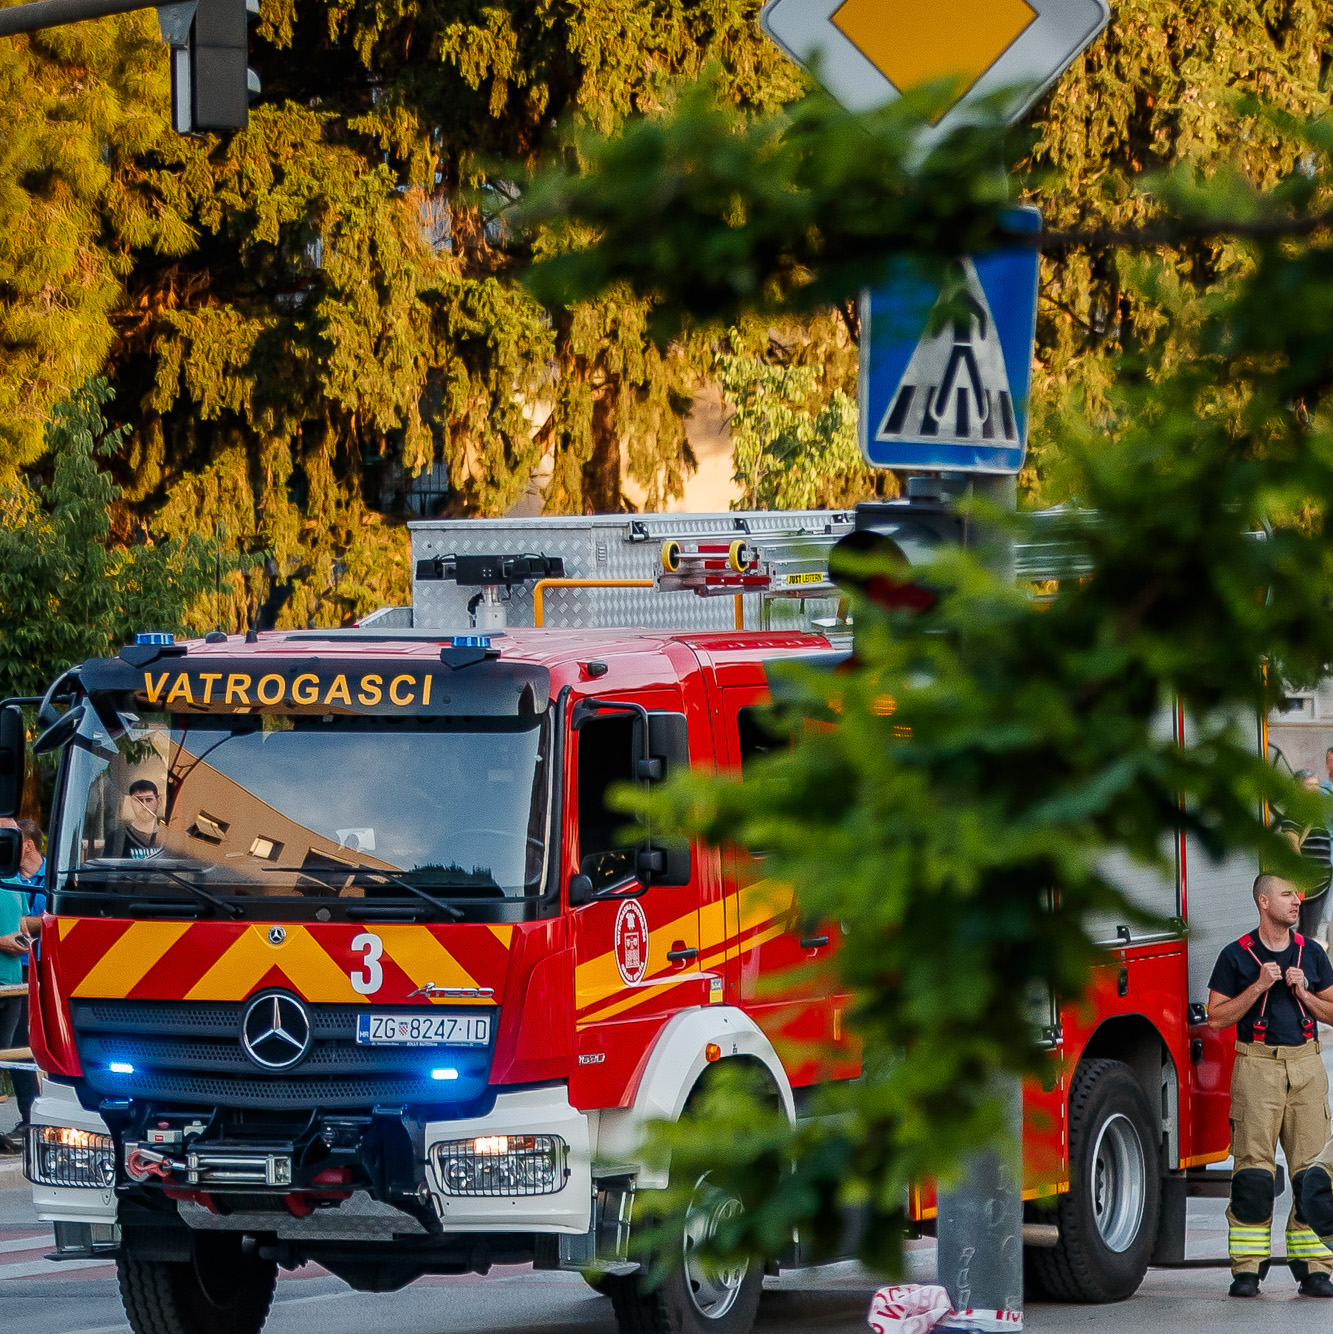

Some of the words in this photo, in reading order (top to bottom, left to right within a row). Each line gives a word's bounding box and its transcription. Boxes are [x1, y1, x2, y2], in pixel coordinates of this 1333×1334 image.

[143, 672, 433, 706] VATROGASCI
[350, 932, 384, 995] 3
[372, 1017, 396, 1039] ZG
